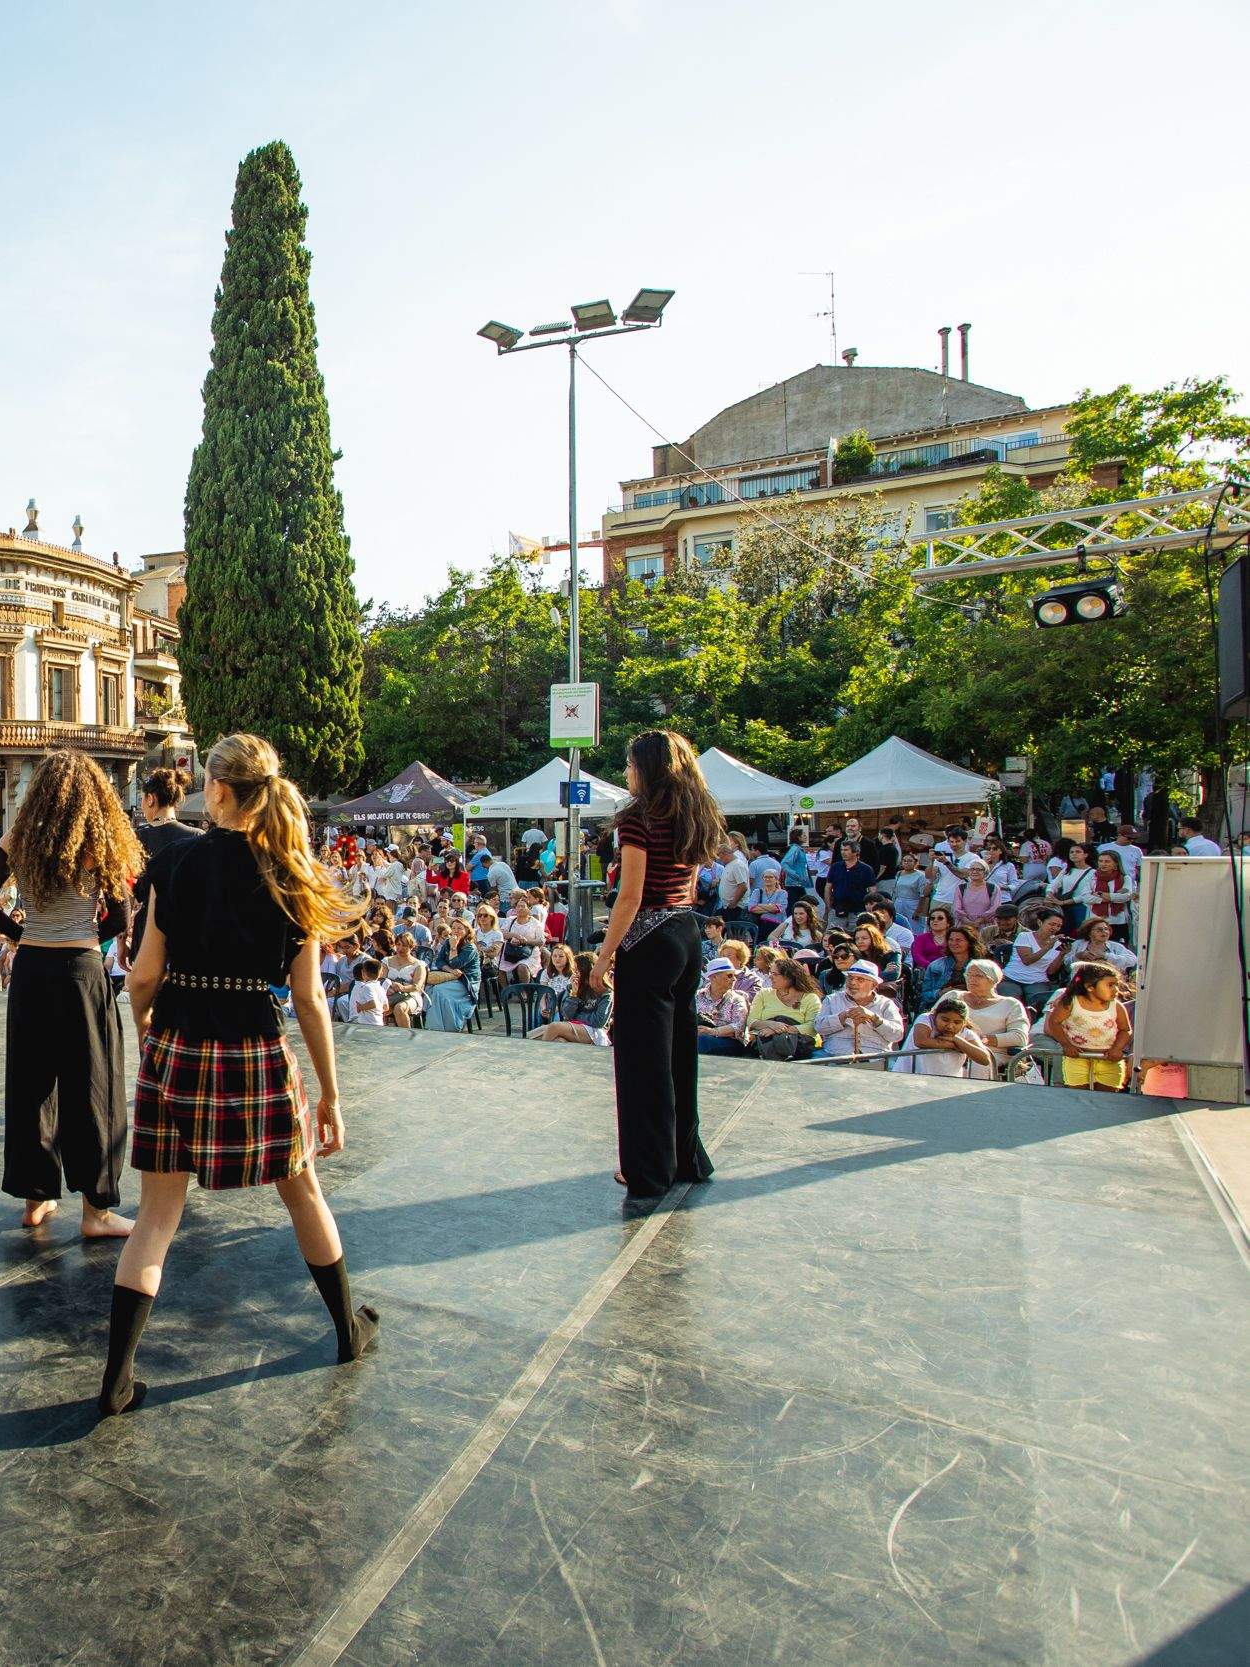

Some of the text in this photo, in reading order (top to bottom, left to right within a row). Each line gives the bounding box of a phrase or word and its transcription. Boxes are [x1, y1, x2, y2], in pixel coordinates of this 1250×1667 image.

[5, 578, 20, 590] DE
[353, 813, 366, 821] ELS
[367, 812, 394, 821] MOJITOS
